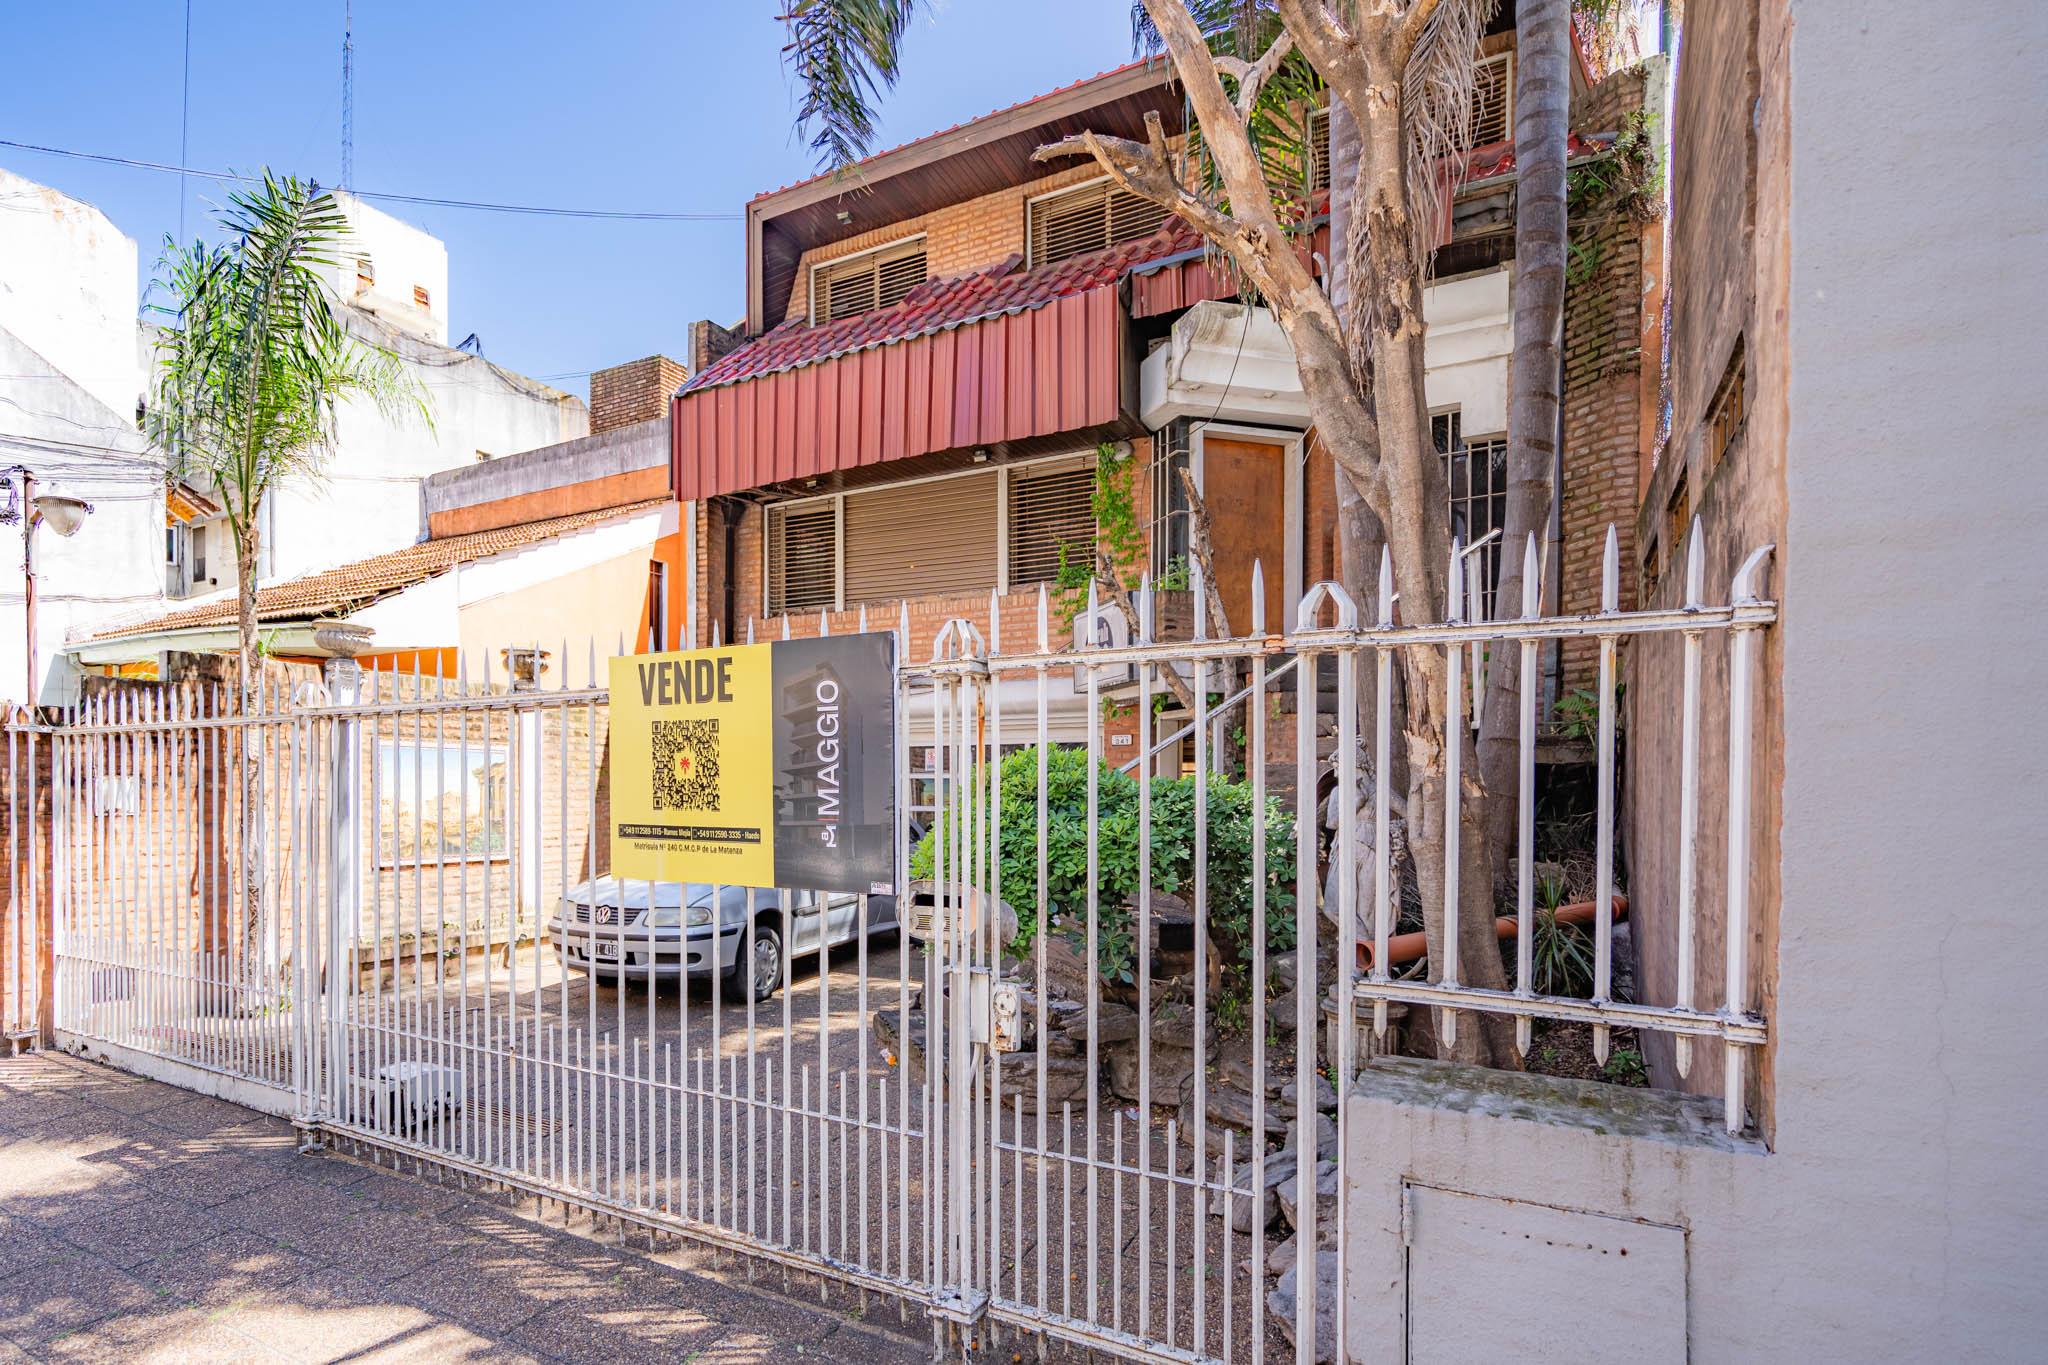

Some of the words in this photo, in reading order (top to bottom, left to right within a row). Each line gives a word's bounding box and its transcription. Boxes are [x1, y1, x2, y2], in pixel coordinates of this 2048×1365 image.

[638, 656, 733, 706] VENDE
[816, 680, 839, 816] MAGGIO
[702, 845, 709, 853] de
[718, 846, 743, 854] Matanza
